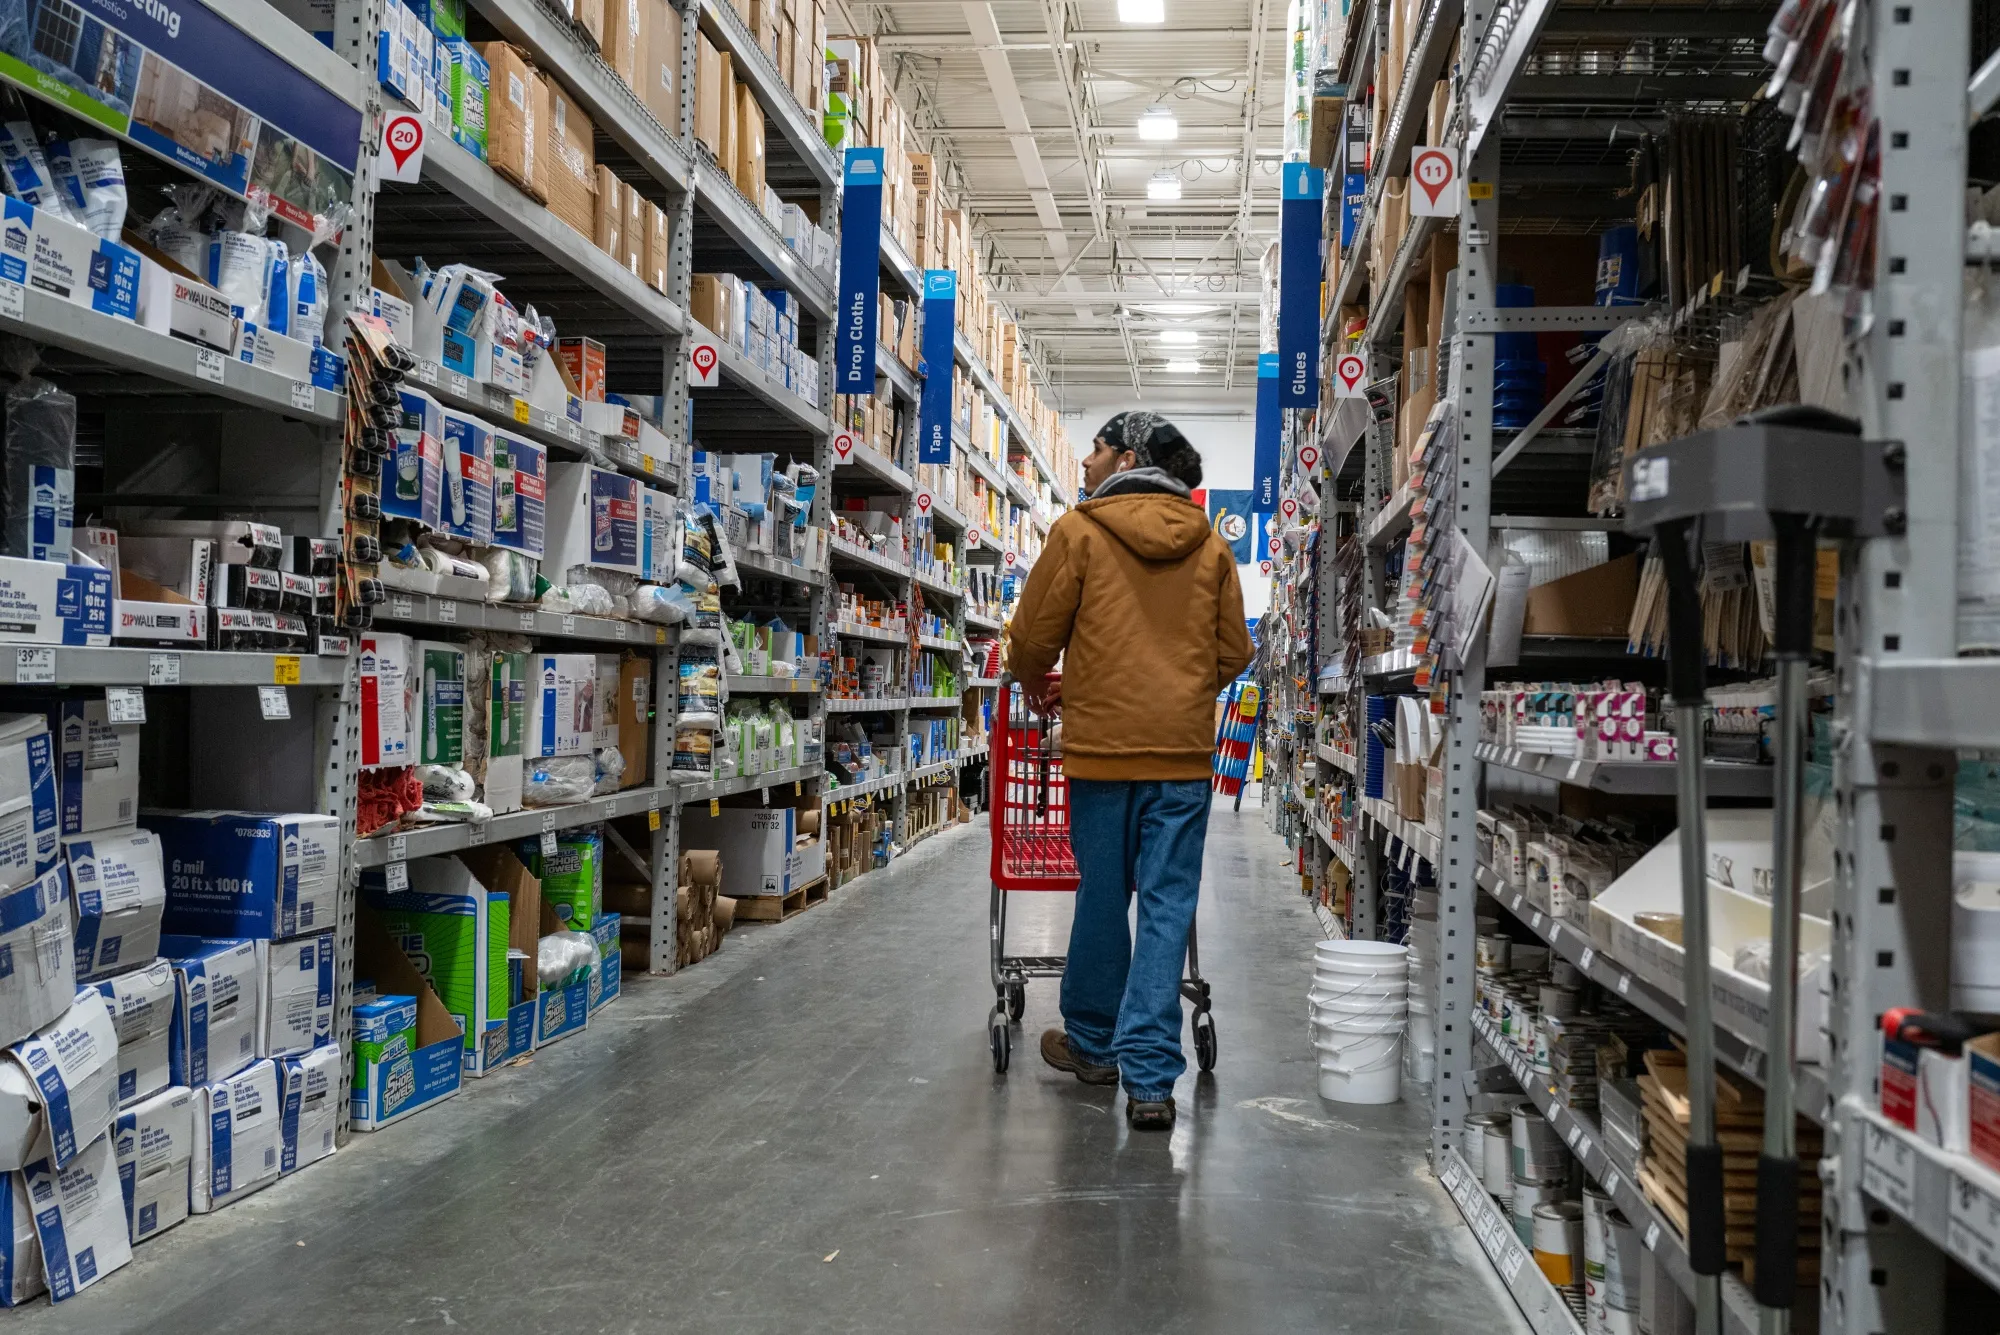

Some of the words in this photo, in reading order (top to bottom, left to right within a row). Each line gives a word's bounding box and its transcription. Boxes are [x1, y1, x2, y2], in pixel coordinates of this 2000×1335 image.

[465, 84, 484, 113] SHOP
[464, 100, 485, 130] TOWELS
[394, 130, 414, 143] 20
[176, 146, 195, 164] Medium
[1424, 166, 1442, 177] 11
[4, 240, 26, 254] SOURCE
[42, 236, 50, 246] mil
[34, 254, 51, 266] Plastic
[51, 259, 73, 276] Sheeting
[118, 262, 124, 272] 3
[124, 264, 134, 277] mil
[114, 274, 122, 285] 10
[116, 288, 125, 302] 25
[175, 284, 208, 308] ZIPWALL
[850, 292, 864, 340] Cloths
[699, 354, 710, 362] 18
[848, 344, 864, 381] Drop
[1292, 352, 1306, 395] Glues
[1347, 366, 1355, 374] 9
[930, 424, 942, 453] Tape
[398, 456, 418, 469] RAGS
[1262, 476, 1272, 504] Caulk
[255, 529, 280, 544] ZIPWALL
[198, 546, 209, 600] ZIPWALL
[250, 572, 278, 588] ZIPWALL
[89, 581, 95, 593] 6
[95, 582, 106, 594] mil
[285, 576, 311, 594] ZIPWALL
[16, 601, 37, 612] Sheeting
[85, 595, 93, 607] 10
[89, 609, 98, 621] 25
[99, 610, 105, 621] ft
[122, 613, 155, 628] ZIPWALL
[221, 614, 250, 628] ZIPWALL
[276, 619, 305, 632] ZIPWALL
[323, 639, 348, 650] ZIPWALL
[234, 828, 271, 838] #0782935
[172, 859, 182, 873] 6
[184, 860, 204, 874] mil
[548, 854, 579, 868] SHOP
[118, 870, 135, 878] Sheeting
[543, 863, 582, 877] TOWELS
[78, 875, 96, 883] SOURCE
[172, 876, 189, 890] 20
[191, 877, 203, 890] ft
[205, 880, 213, 891] x
[215, 878, 239, 893] 100
[242, 880, 253, 893] ft
[192, 993, 206, 1002] SOURCE
[546, 1002, 565, 1020] SHOP
[544, 1014, 565, 1038] TOWELS
[58, 1043, 71, 1054] Plastic
[71, 1032, 89, 1046] Sheeting
[375, 1033, 388, 1042] BOX
[390, 1040, 407, 1057] BLUE
[29, 1050, 46, 1064] PROJECT
[32, 1057, 51, 1071] SOURCE
[396, 1062, 412, 1077] BLUE
[388, 1070, 413, 1092] SHOP
[246, 1091, 260, 1100] Sheeting
[384, 1081, 414, 1114] TOWELS
[213, 1100, 228, 1109] SOURCE
[141, 1141, 154, 1150] Plastic
[154, 1135, 170, 1145] Sheeting
[117, 1147, 134, 1158] SOURCE
[61, 1182, 75, 1192] Plastic
[76, 1174, 93, 1186] Sheeting
[34, 1192, 54, 1204] SOURCE
